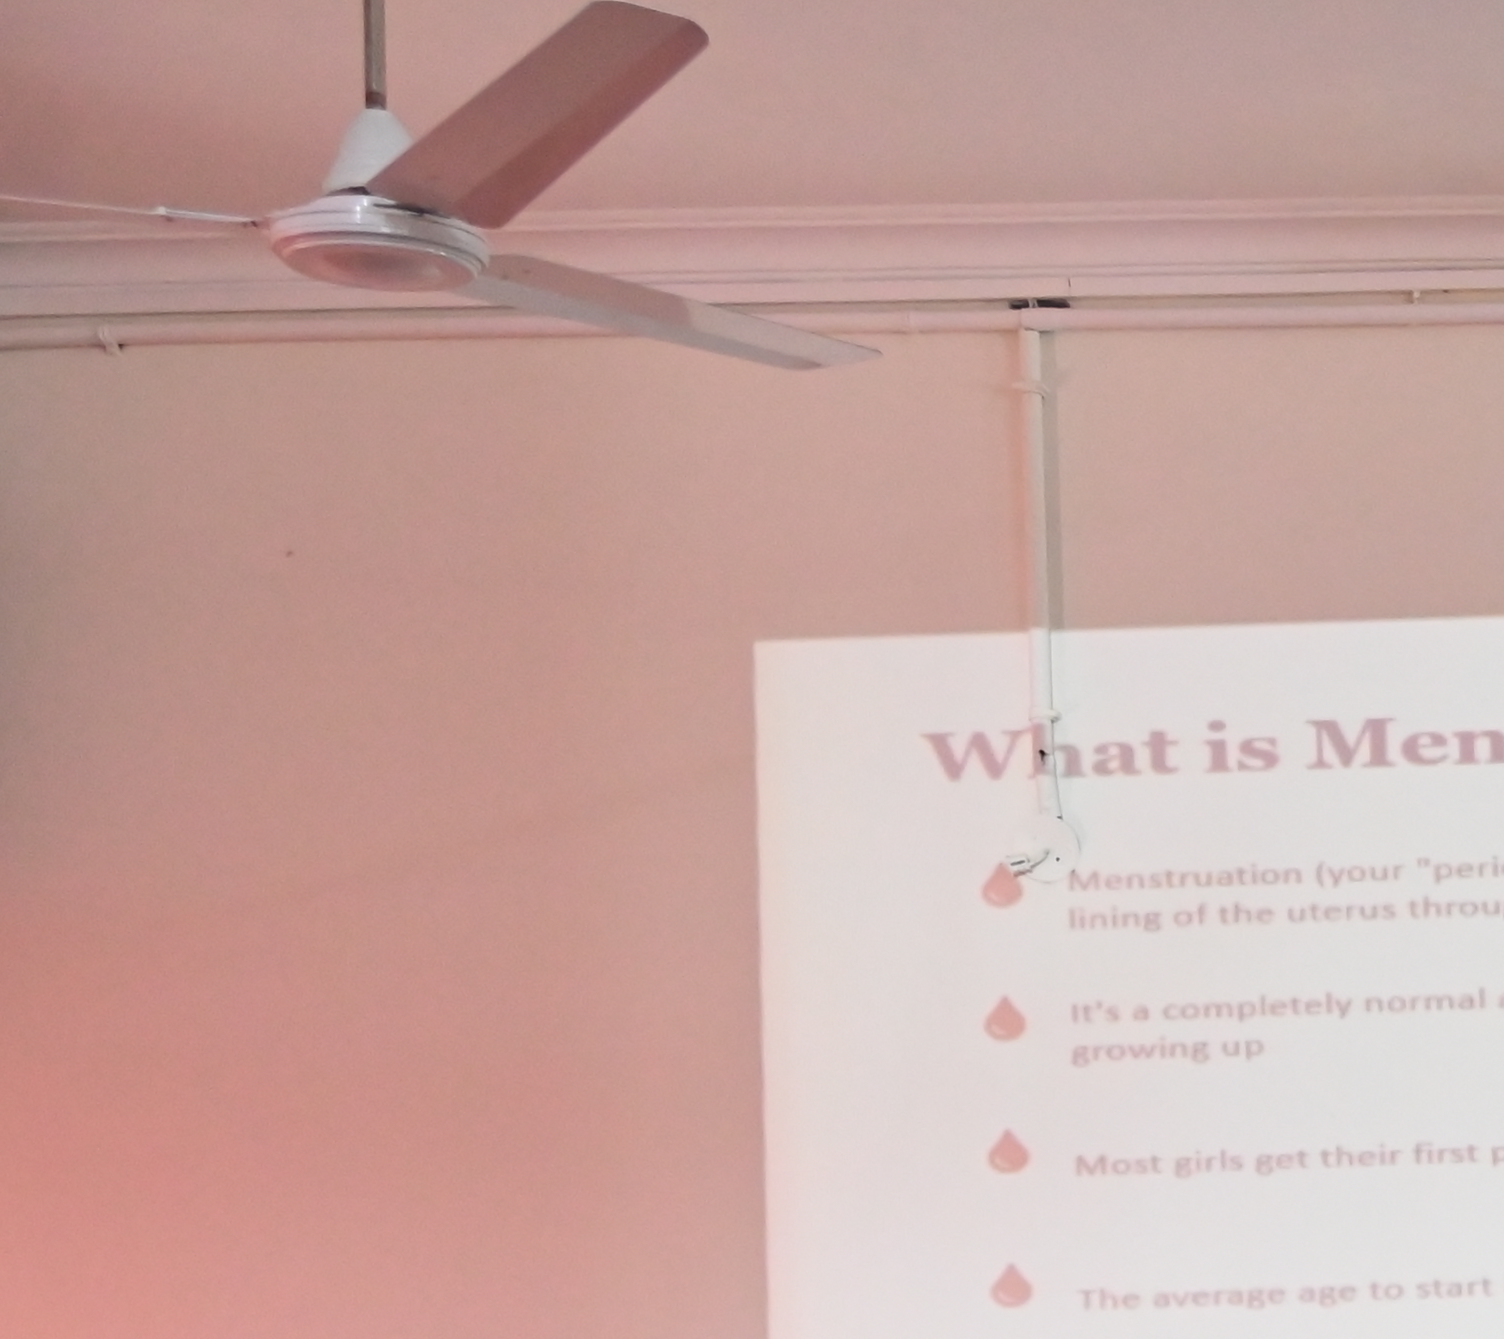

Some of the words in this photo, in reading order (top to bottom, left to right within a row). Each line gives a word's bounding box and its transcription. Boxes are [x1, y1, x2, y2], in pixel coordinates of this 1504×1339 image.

[922, 721, 1180, 784] What
[1205, 719, 1280, 774] is
[1066, 863, 1304, 892] Menstruation
[1314, 861, 1404, 889] (your
[1068, 906, 1163, 933] lining
[1172, 902, 1208, 928] of
[1217, 901, 1275, 926] the
[1286, 902, 1398, 924] uterus
[1070, 1000, 1122, 1024] It's
[1131, 1003, 1151, 1023] a
[1161, 991, 1353, 1023] completely
[1363, 986, 1487, 1014] normal
[1070, 1037, 1211, 1069] growing
[1220, 1039, 1265, 1062] up
[1074, 1153, 1162, 1177] Most
[1173, 1148, 1245, 1179] girls
[1254, 1148, 1309, 1177] get
[1319, 1143, 1402, 1169] their
[1412, 1141, 1478, 1166] first
[1078, 1287, 1142, 1312] The
[1152, 1287, 1287, 1310] average
[1297, 1284, 1358, 1307] age
[1368, 1281, 1406, 1302] to
[1415, 1276, 1493, 1300] start
